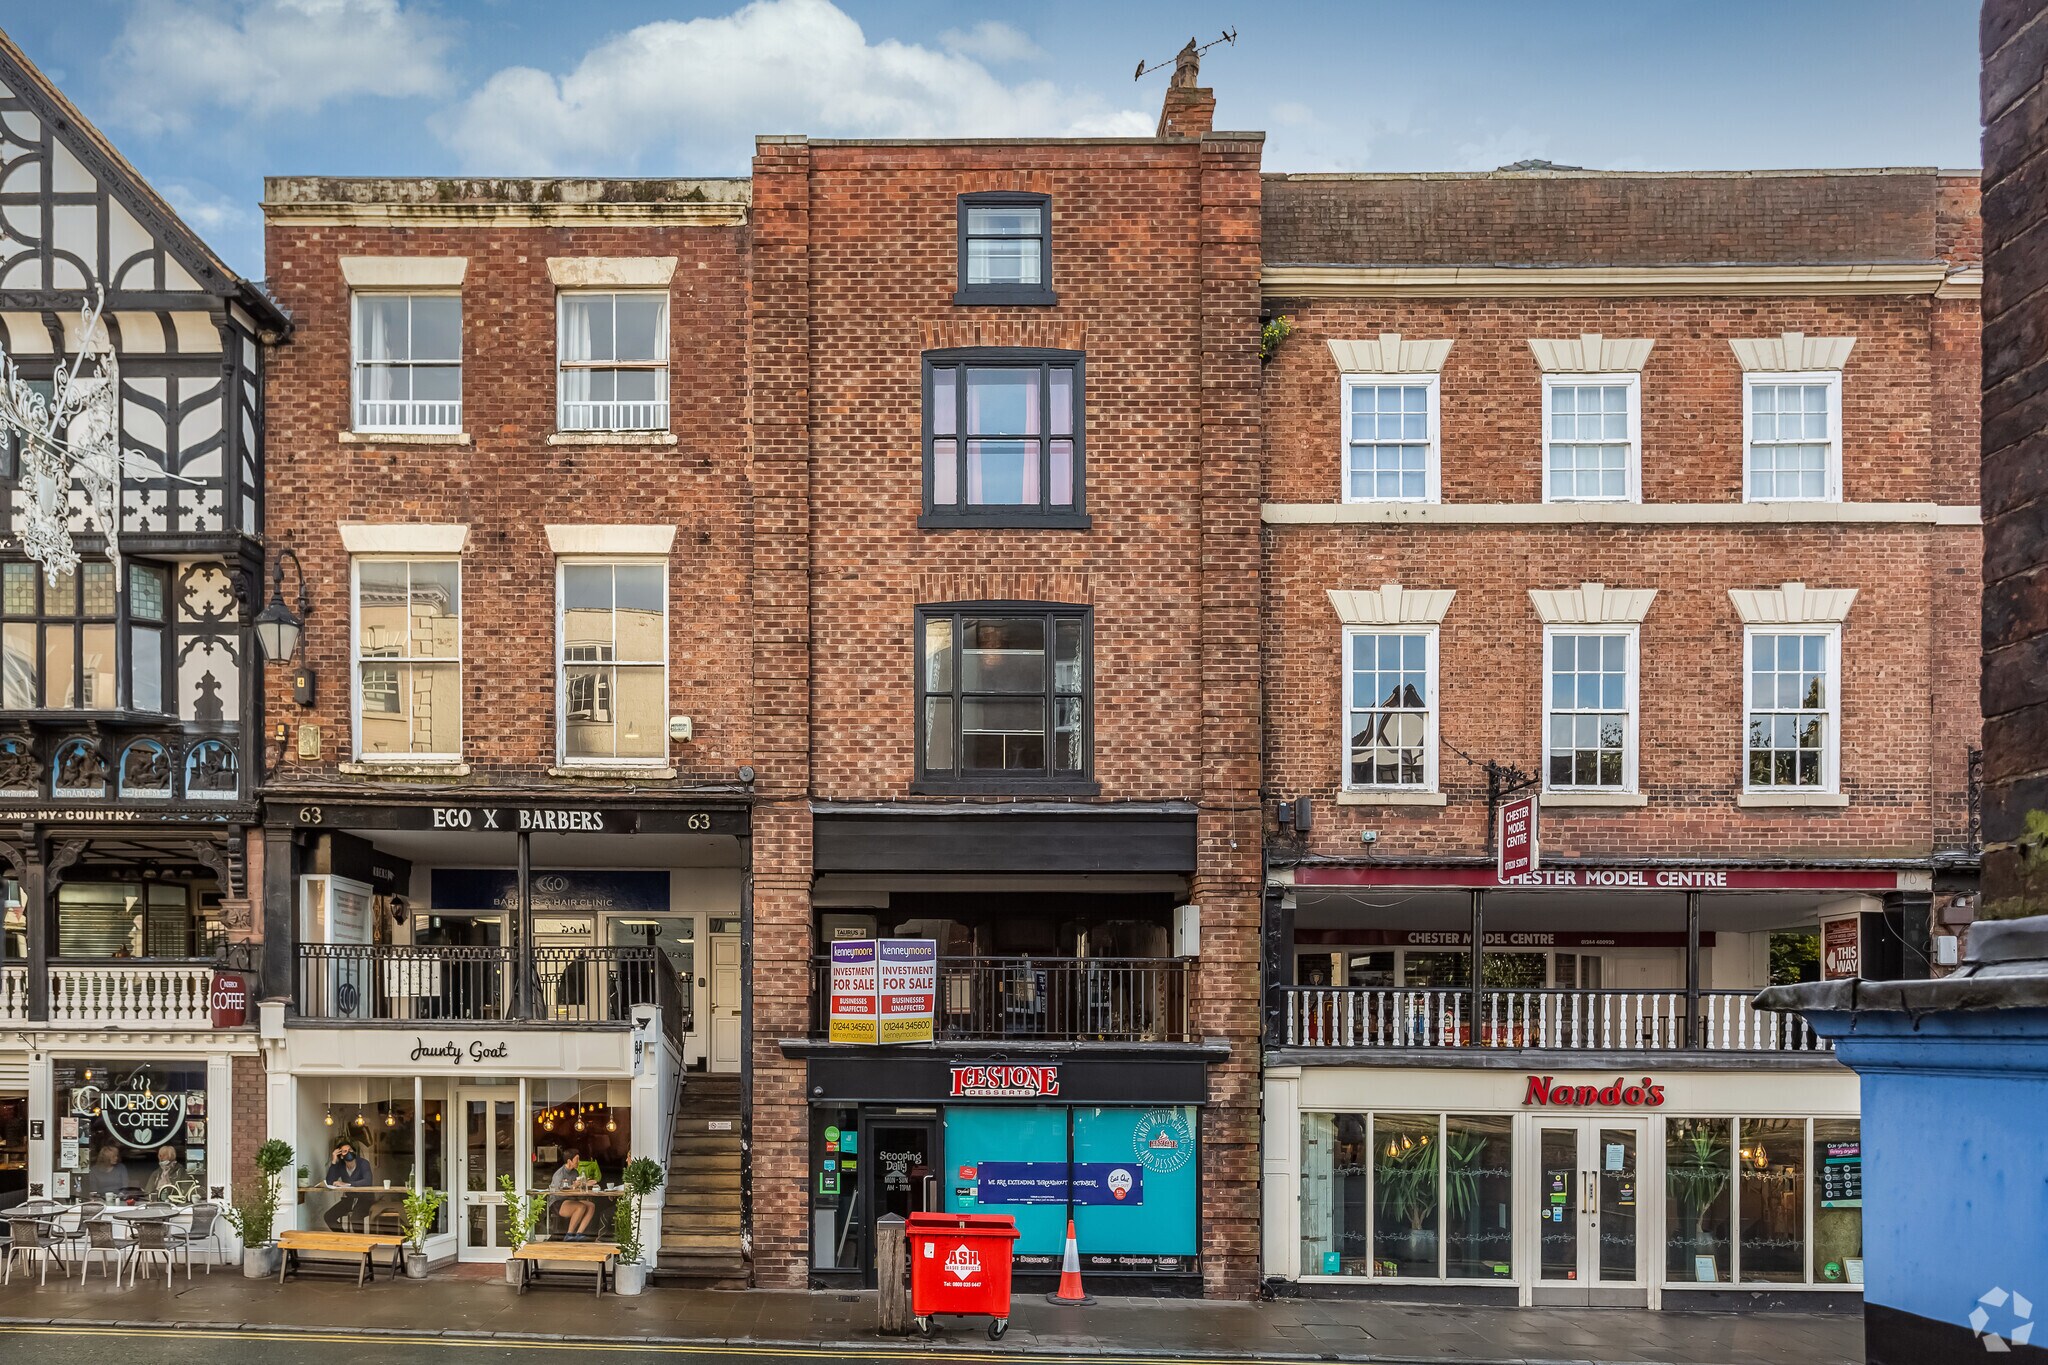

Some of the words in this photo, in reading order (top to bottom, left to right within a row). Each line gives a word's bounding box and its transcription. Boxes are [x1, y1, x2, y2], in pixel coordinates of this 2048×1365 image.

[6, 811, 28, 820] AND
[38, 811, 57, 820] MY
[65, 811, 134, 821] COUNTRY
[299, 806, 322, 825] 63
[432, 808, 472, 828] EGO
[482, 808, 499, 829] X
[518, 809, 604, 831] BARBERS
[1505, 805, 1529, 823] CHESTER
[687, 813, 711, 830] 63
[1507, 820, 1526, 836] MODEL
[1506, 832, 1527, 849] CENTRE
[1585, 871, 1649, 886] MODEL
[1656, 871, 1728, 887] CENTRE
[493, 898, 541, 908] BARBRS
[553, 899, 580, 907] HAIR
[580, 899, 613, 908] CLINIC
[836, 929, 859, 937] TAURUS
[1407, 932, 1459, 944] CHESTER
[1463, 933, 1507, 945] MDEL
[1510, 933, 1555, 945] CENTRE
[833, 945, 873, 959] kenneymoore
[882, 943, 932, 958] kenneymoore
[1836, 945, 1857, 960] THIS
[833, 966, 875, 976] INVESTMENT
[882, 965, 934, 976] INVESTMENT
[1836, 959, 1858, 973] WAY
[833, 979, 850, 991] FOR
[852, 978, 875, 991] SALE
[883, 978, 906, 990] FOR
[908, 977, 934, 989] SALE
[212, 991, 245, 1010] COFFEE
[839, 997, 868, 1005] BUSINESSES
[891, 996, 925, 1004] BUSINESSES
[838, 1004, 869, 1013] UNAFFECTED
[890, 1003, 926, 1012] UNAFFECTED
[832, 1022, 850, 1031] 01244
[850, 1022, 875, 1032] 345600
[883, 1021, 905, 1031] 01244
[905, 1020, 930, 1030] 345600
[410, 1036, 464, 1065] Jaunty
[469, 1040, 508, 1063] Goat
[1521, 1075, 1665, 1107] Nando's
[76, 1085, 179, 1117] CINDERBOX
[117, 1112, 169, 1127] COFFEE
[879, 1150, 922, 1165] Scooping
[1140, 1149, 1154, 1164] AND
[1154, 1149, 1187, 1169] DESSERTS
[885, 1160, 908, 1173] Daily
[884, 1176, 896, 1184] MON
[898, 1176, 909, 1184] SUN
[1109, 1175, 1120, 1183] Eat
[1119, 1173, 1130, 1183] Out
[948, 1251, 978, 1265] ASH
[1020, 1255, 1050, 1264] Desserts
[1091, 1256, 1112, 1264] Cakes
[1158, 1256, 1178, 1264] Latte
